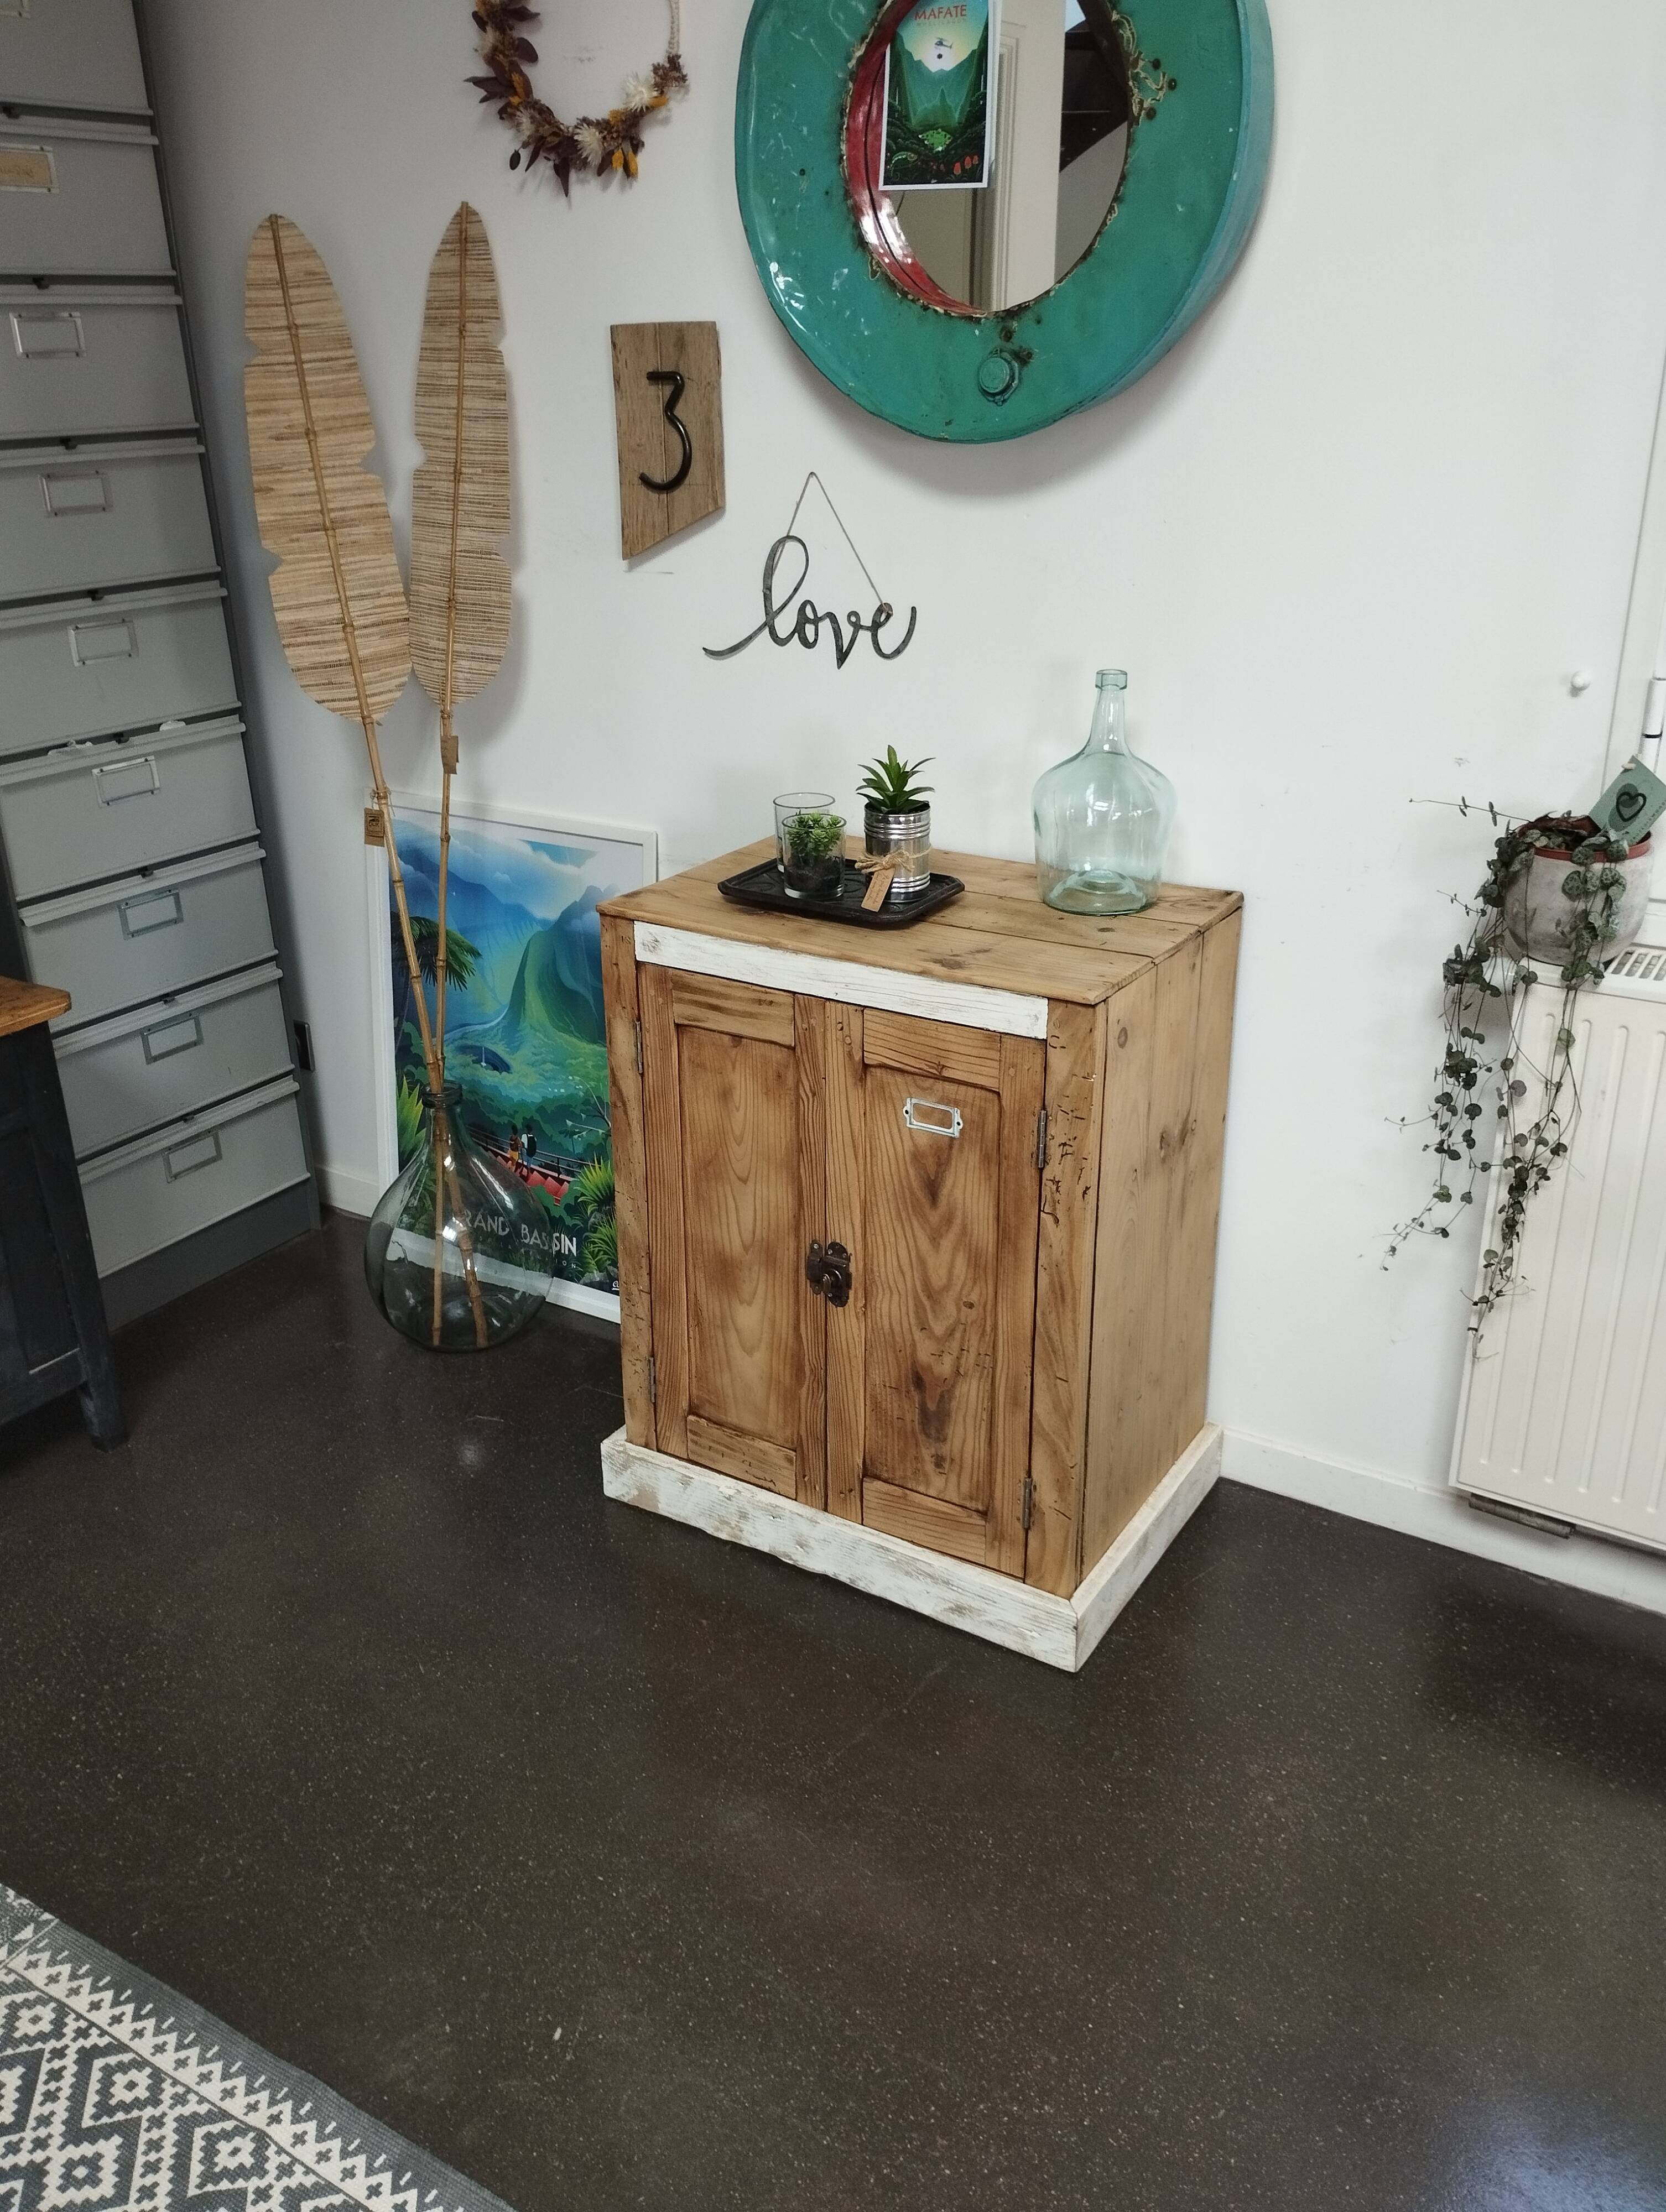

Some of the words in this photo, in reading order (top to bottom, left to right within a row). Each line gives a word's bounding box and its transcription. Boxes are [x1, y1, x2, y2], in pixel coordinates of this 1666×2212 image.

[914, 4, 967, 20] MAFATE
[639, 371, 693, 494] 3
[702, 535, 917, 670] love
[463, 1208, 510, 1236] RAND
